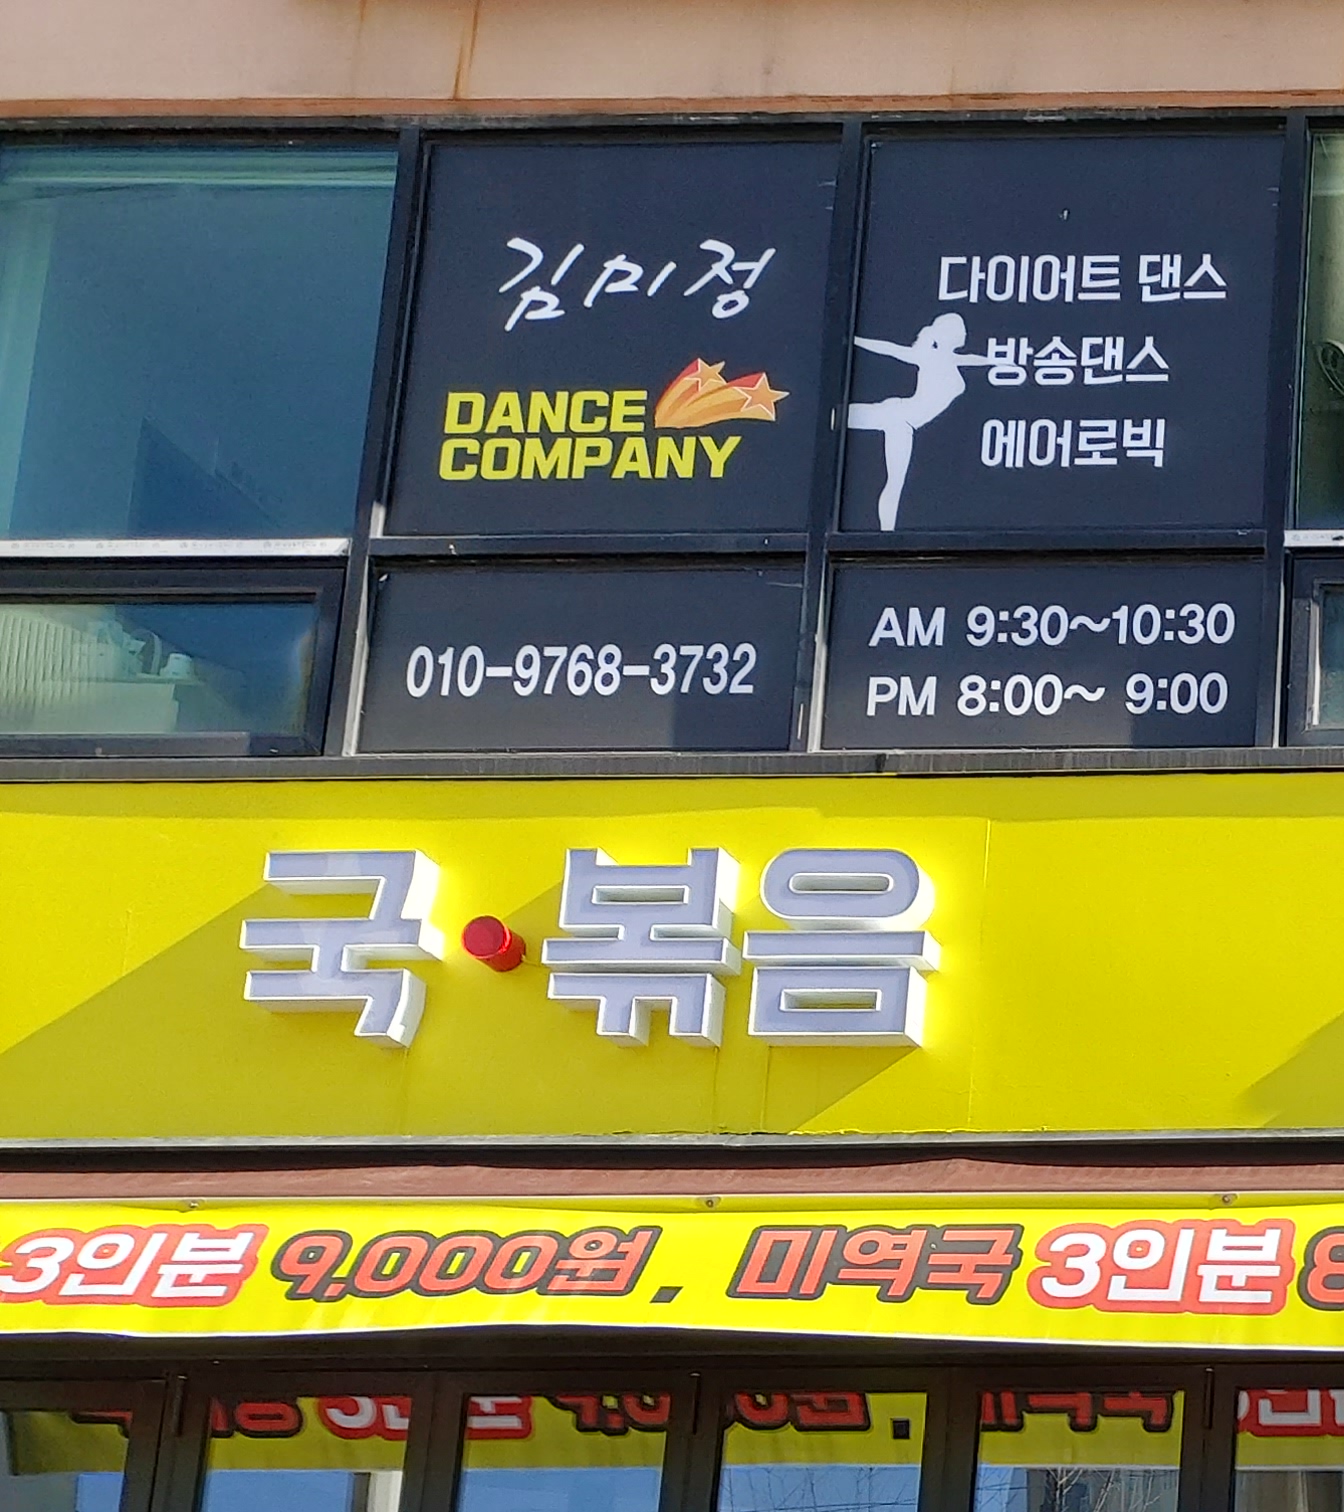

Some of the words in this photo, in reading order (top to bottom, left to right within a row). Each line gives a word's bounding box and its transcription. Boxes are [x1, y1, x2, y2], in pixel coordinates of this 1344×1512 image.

[498, 236, 776, 331] 김미정
[937, 253, 1122, 305] 다이어트
[1137, 251, 1227, 302] 댄스
[988, 336, 1170, 386] 방송댄스
[442, 389, 647, 436] DANCE
[438, 436, 741, 481] COMPANY
[980, 418, 1167, 469] 에어로빅
[869, 608, 944, 648] AM
[967, 604, 1236, 646] 9:30~10:30
[407, 642, 757, 698] 010-9768-3732
[868, 678, 935, 716] PM
[1126, 673, 1228, 714] 9:00
[0, 1224, 266, 1306] 3인분
[726, 1224, 1023, 1305] 미역국
[1028, 1218, 1295, 1314] 3인분
